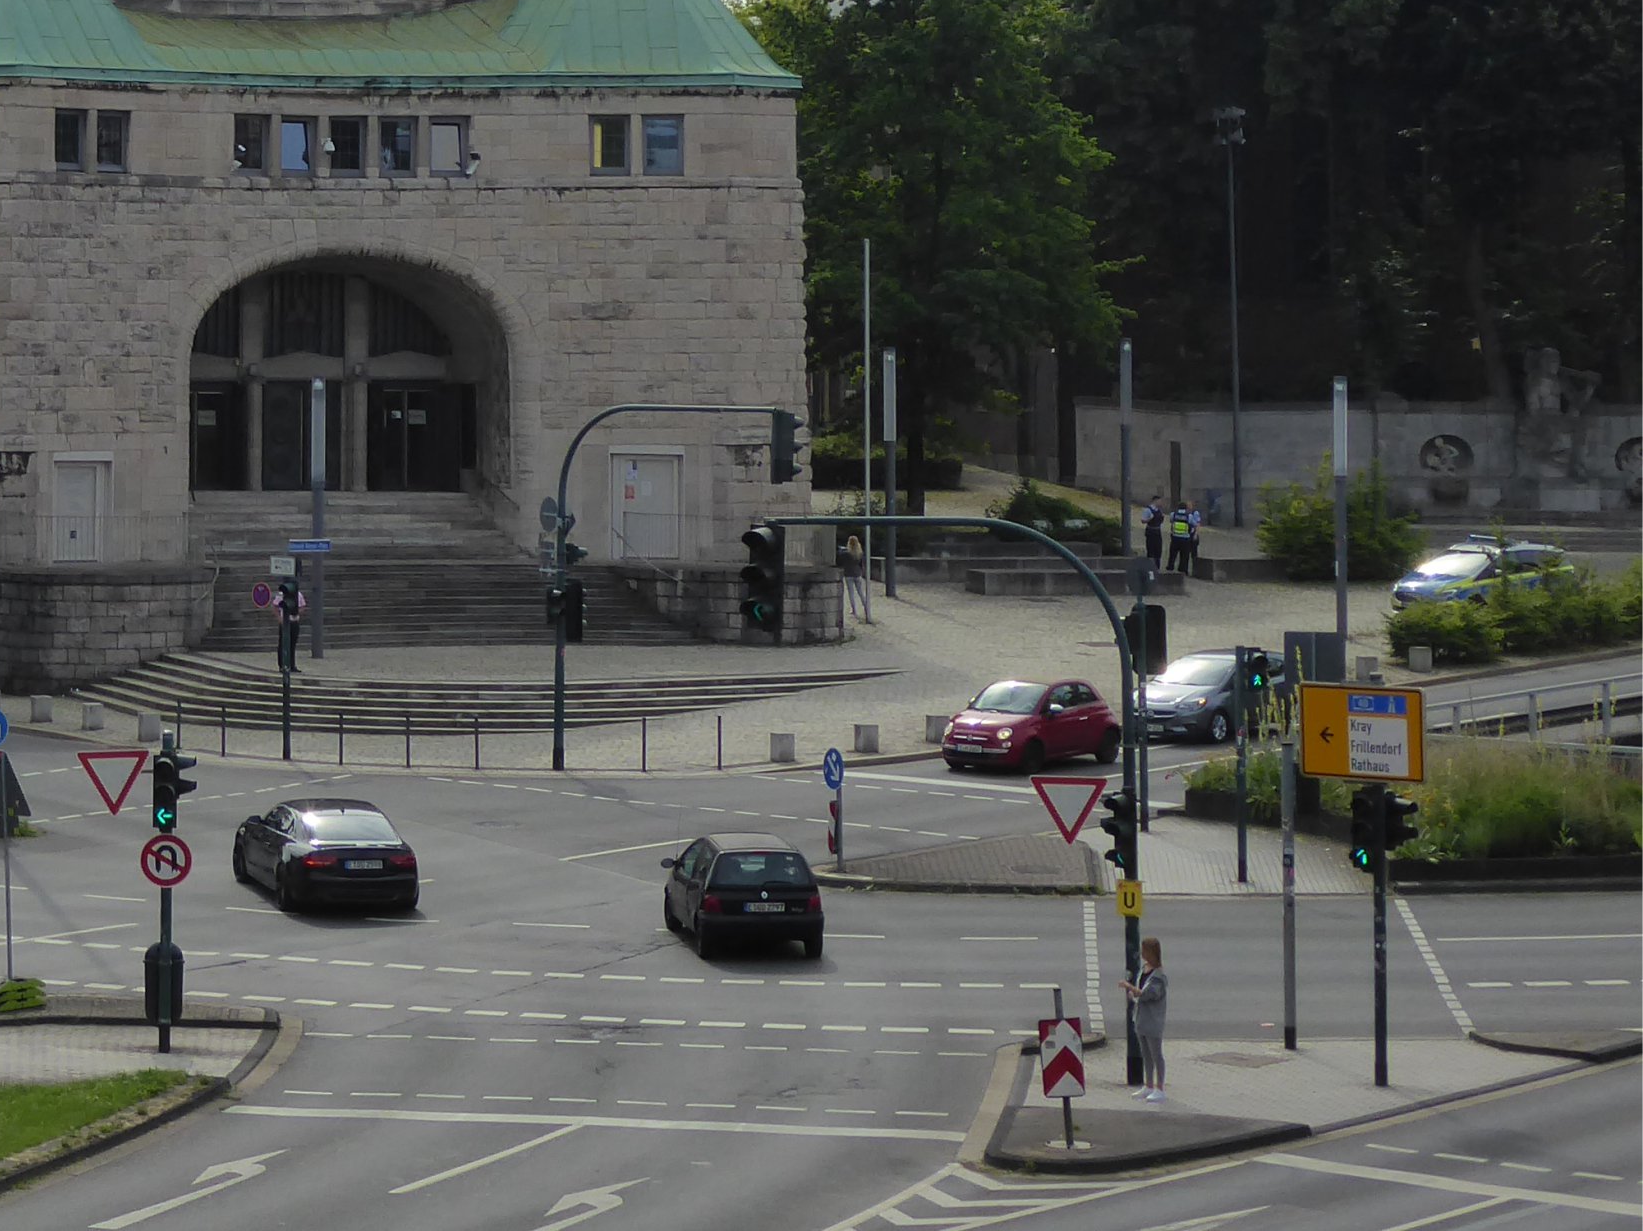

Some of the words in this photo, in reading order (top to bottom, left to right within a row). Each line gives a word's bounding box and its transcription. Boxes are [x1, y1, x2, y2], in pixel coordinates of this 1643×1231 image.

[1350, 719, 1372, 735] Kray
[1351, 740, 1402, 756] Frillendorf
[1351, 758, 1390, 773] Rathaus
[1124, 891, 1135, 909] U
